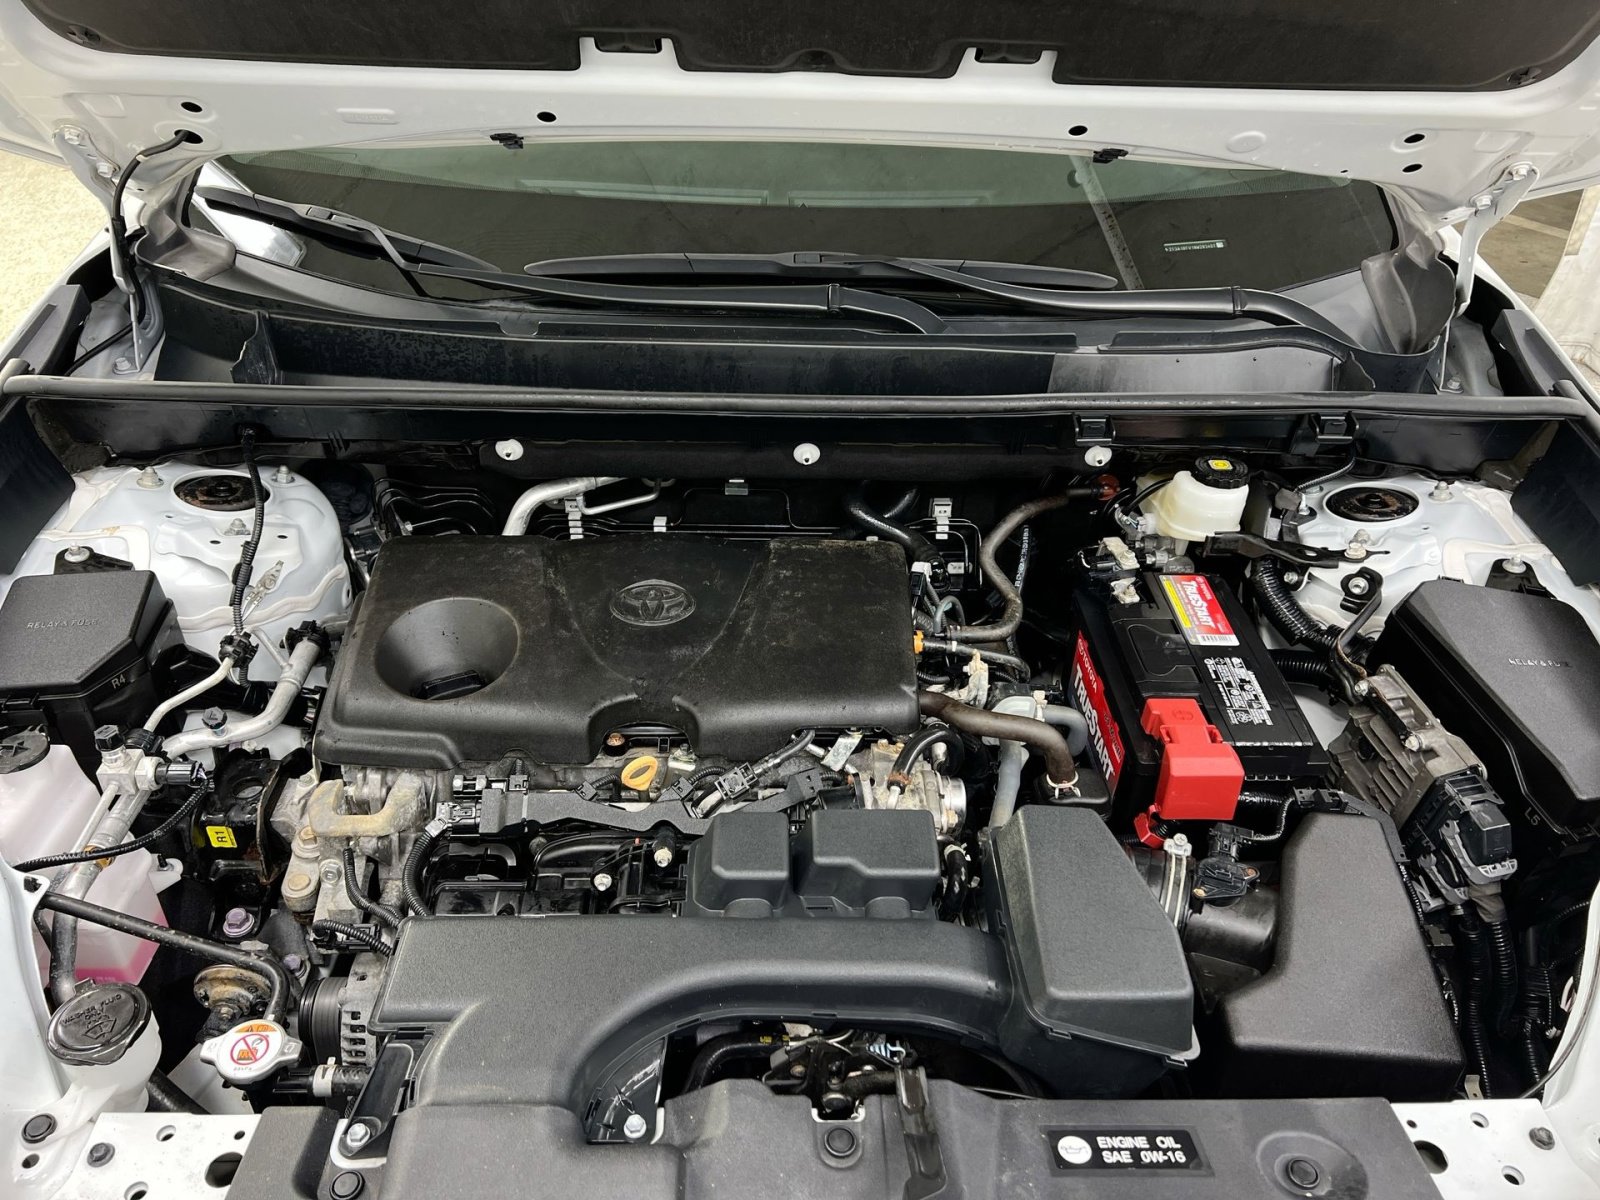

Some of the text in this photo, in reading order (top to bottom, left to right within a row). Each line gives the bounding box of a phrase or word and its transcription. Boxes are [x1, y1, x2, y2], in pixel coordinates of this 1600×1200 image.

[1181, 580, 1217, 629] TRUESTART
[26, 621, 60, 629] RELAY
[1082, 652, 1097, 693] TOYOTA
[111, 674, 126, 689] R4
[1073, 664, 1114, 781] TRUESTART
[1524, 806, 1541, 826] L5
[215, 831, 228, 843] R1
[1096, 1136, 1181, 1149] ENGINE OIL
[1102, 1150, 1186, 1164] SAE 0W-16
